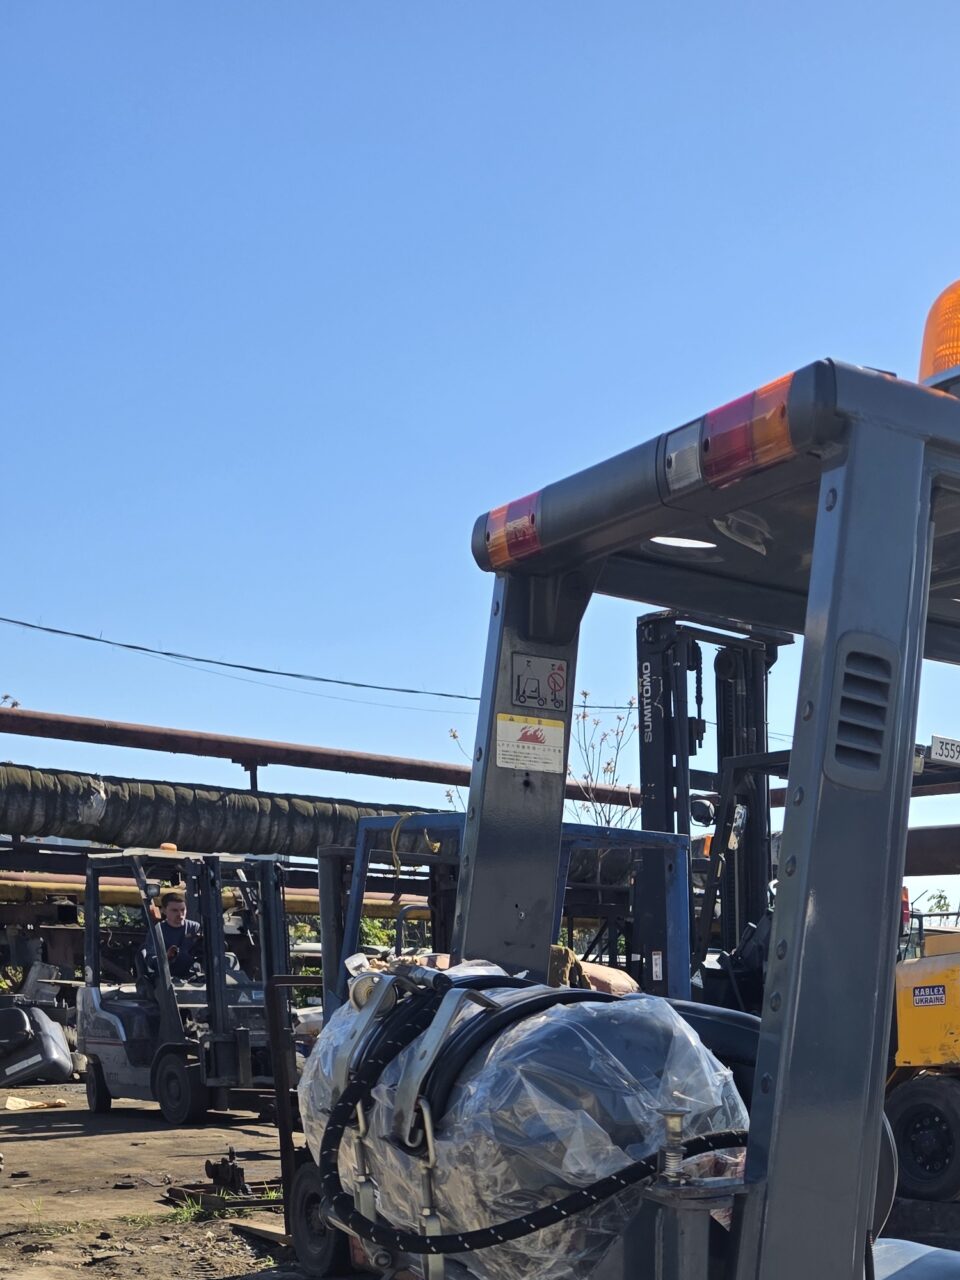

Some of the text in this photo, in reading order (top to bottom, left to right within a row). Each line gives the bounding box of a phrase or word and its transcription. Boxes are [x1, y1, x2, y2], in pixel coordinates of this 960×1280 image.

[642, 661, 653, 743] SUMITOMO
[914, 986, 944, 996] KABLEX
[915, 995, 945, 1005] UKRAINE
